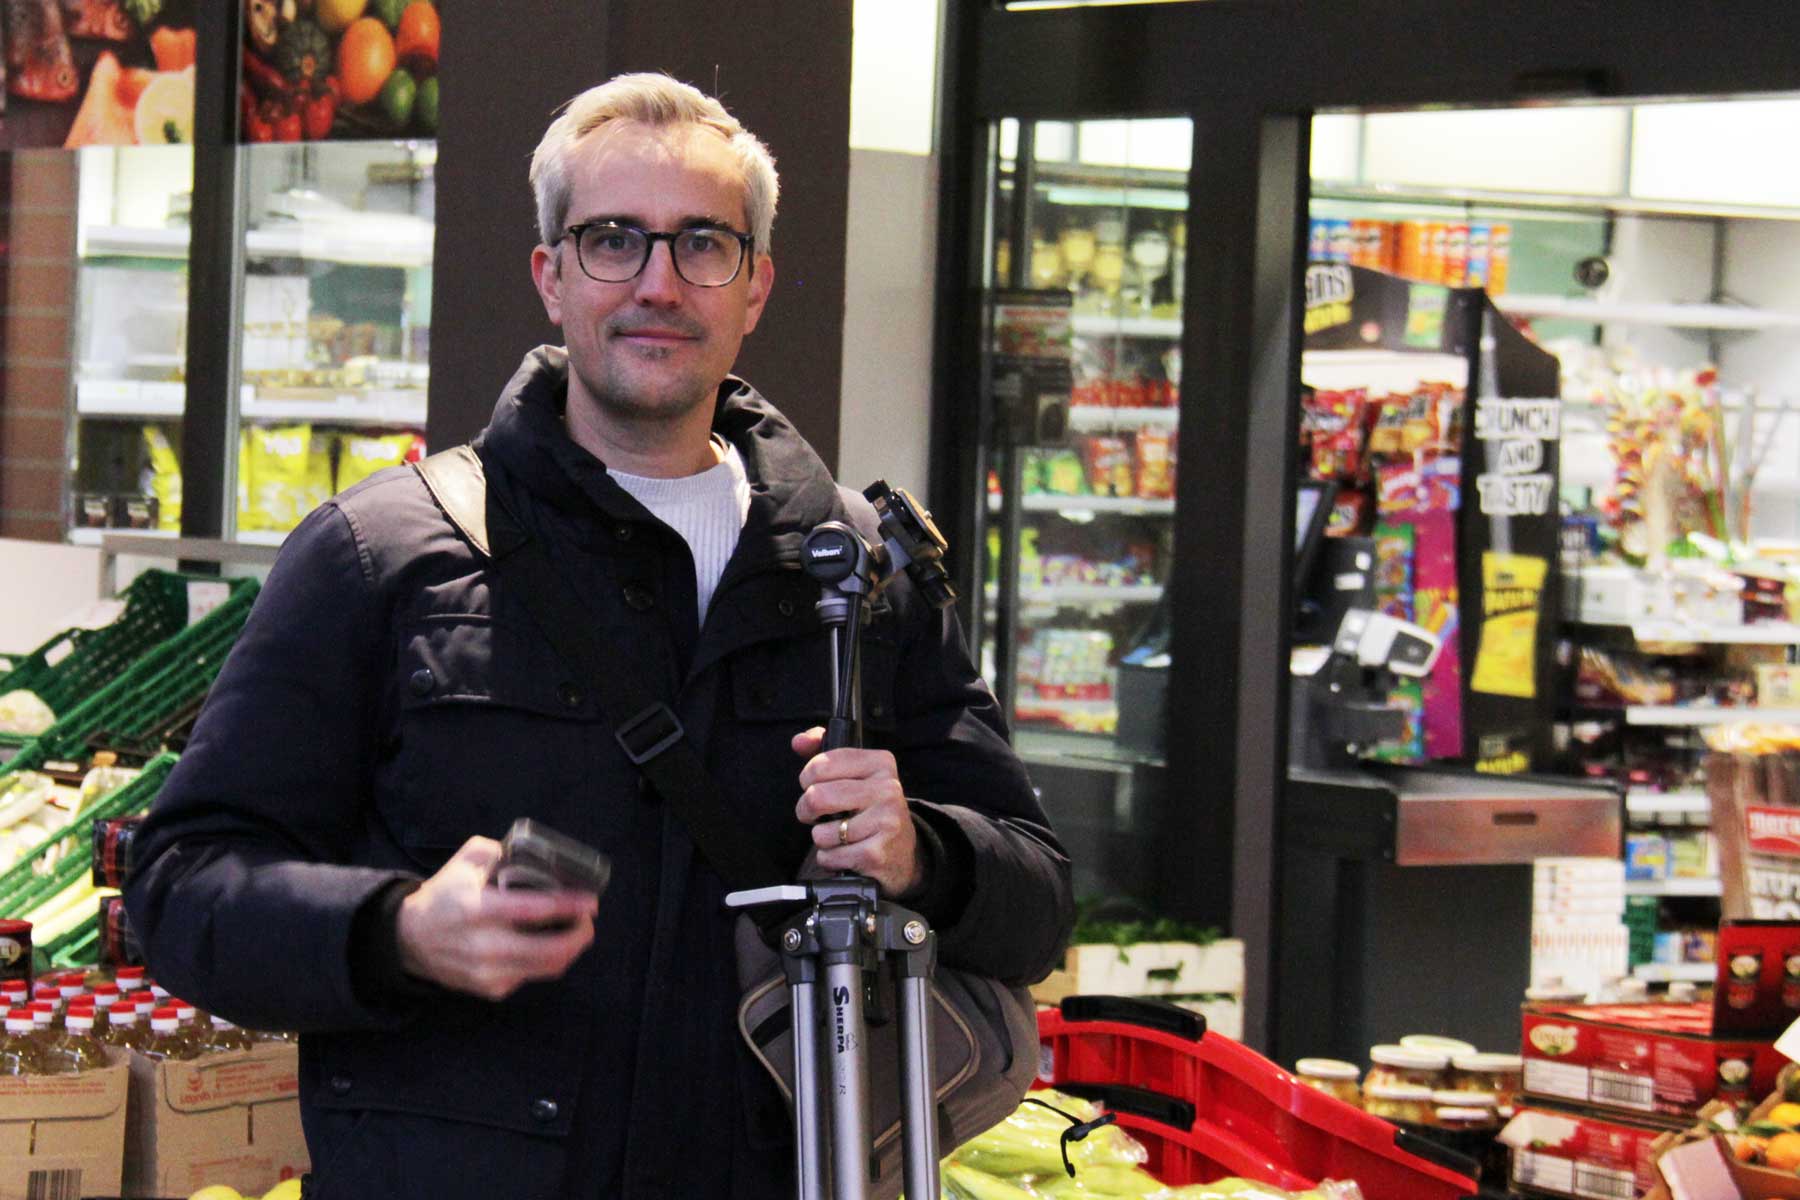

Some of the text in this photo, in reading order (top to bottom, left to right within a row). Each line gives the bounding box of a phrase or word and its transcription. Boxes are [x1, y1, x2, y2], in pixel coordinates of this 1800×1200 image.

[1476, 403, 1553, 433] UNCH
[1503, 443, 1536, 465] AND
[1483, 481, 1546, 509] TSTY
[833, 986, 849, 1053] SHERPA
